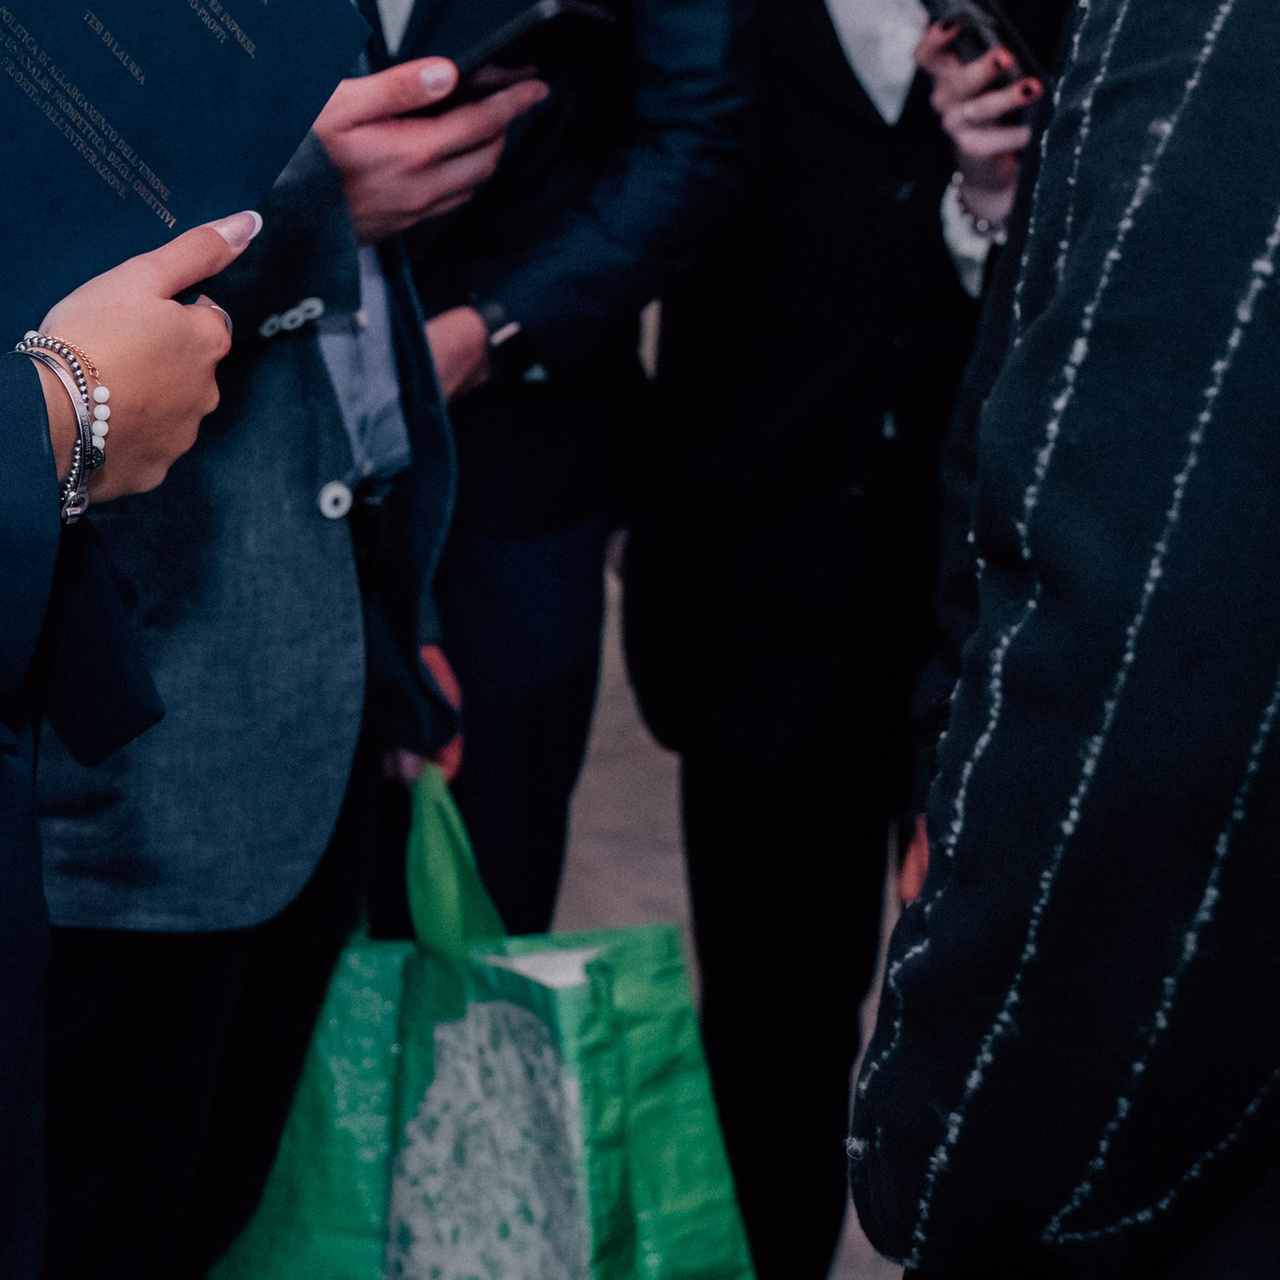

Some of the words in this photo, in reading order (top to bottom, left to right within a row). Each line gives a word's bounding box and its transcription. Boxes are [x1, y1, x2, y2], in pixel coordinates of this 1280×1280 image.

[80, 8, 106, 36] TESI
[99, 30, 116, 47] DI
[109, 41, 150, 87] LAUREA
[104, 149, 136, 183] DEGLI
[130, 178, 178, 228] OBIETTIVI
